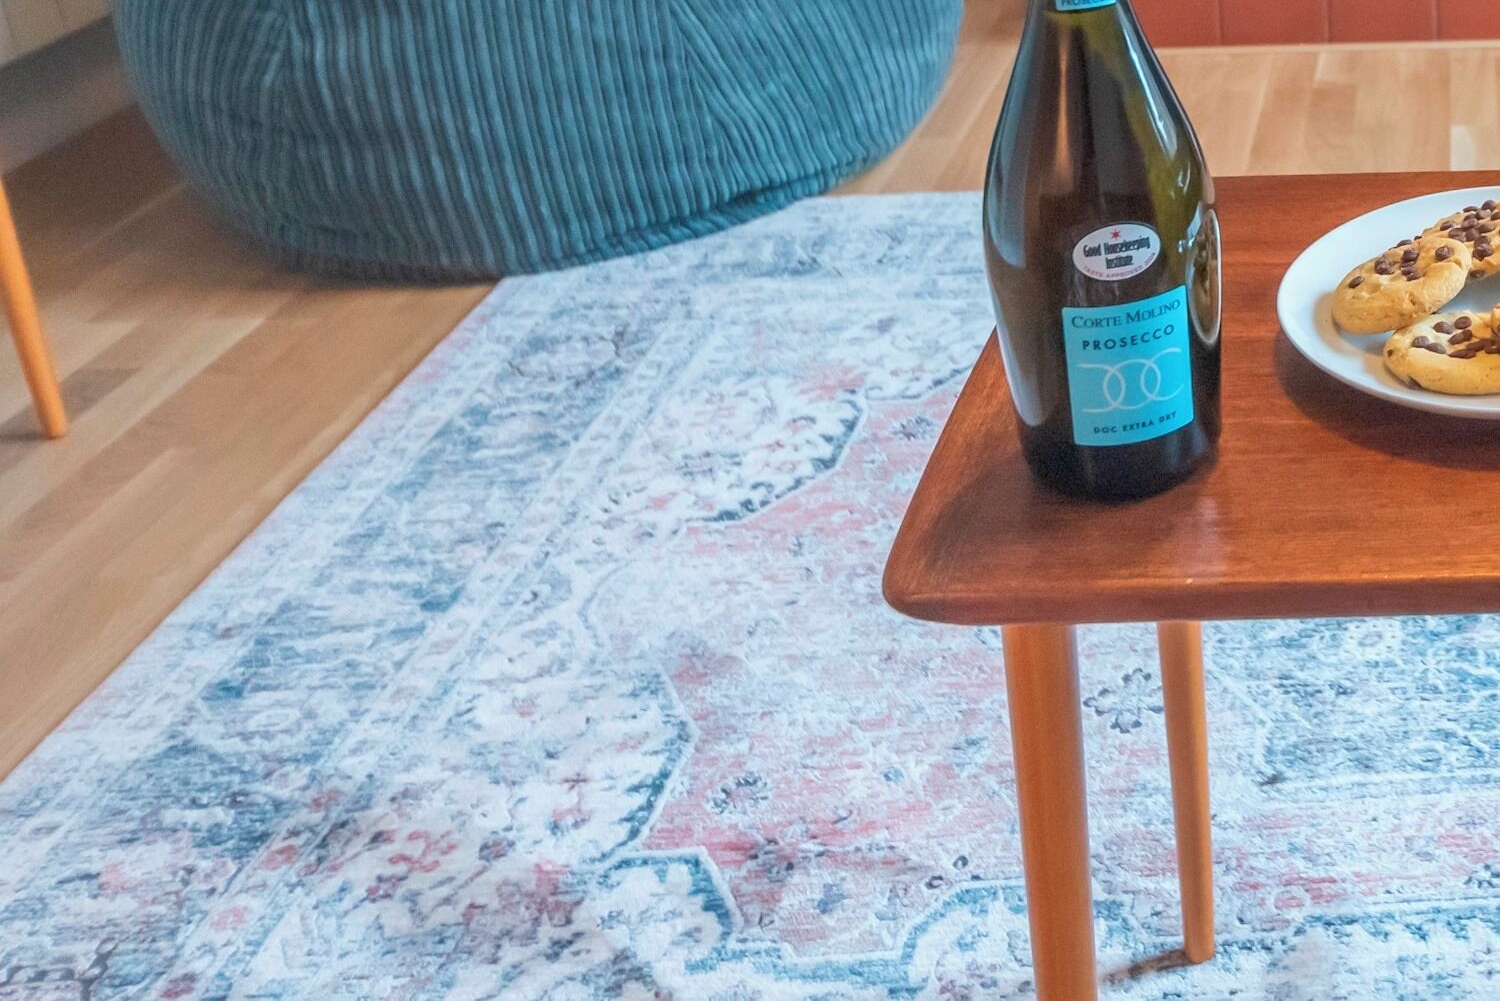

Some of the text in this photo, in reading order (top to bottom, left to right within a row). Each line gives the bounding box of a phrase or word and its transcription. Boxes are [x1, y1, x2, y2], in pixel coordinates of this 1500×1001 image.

[1071, 299, 1181, 329] CORTE MOLINO
[1082, 324, 1175, 351] PROSECCO
[1093, 410, 1177, 435] DOC EXTRA DRY
